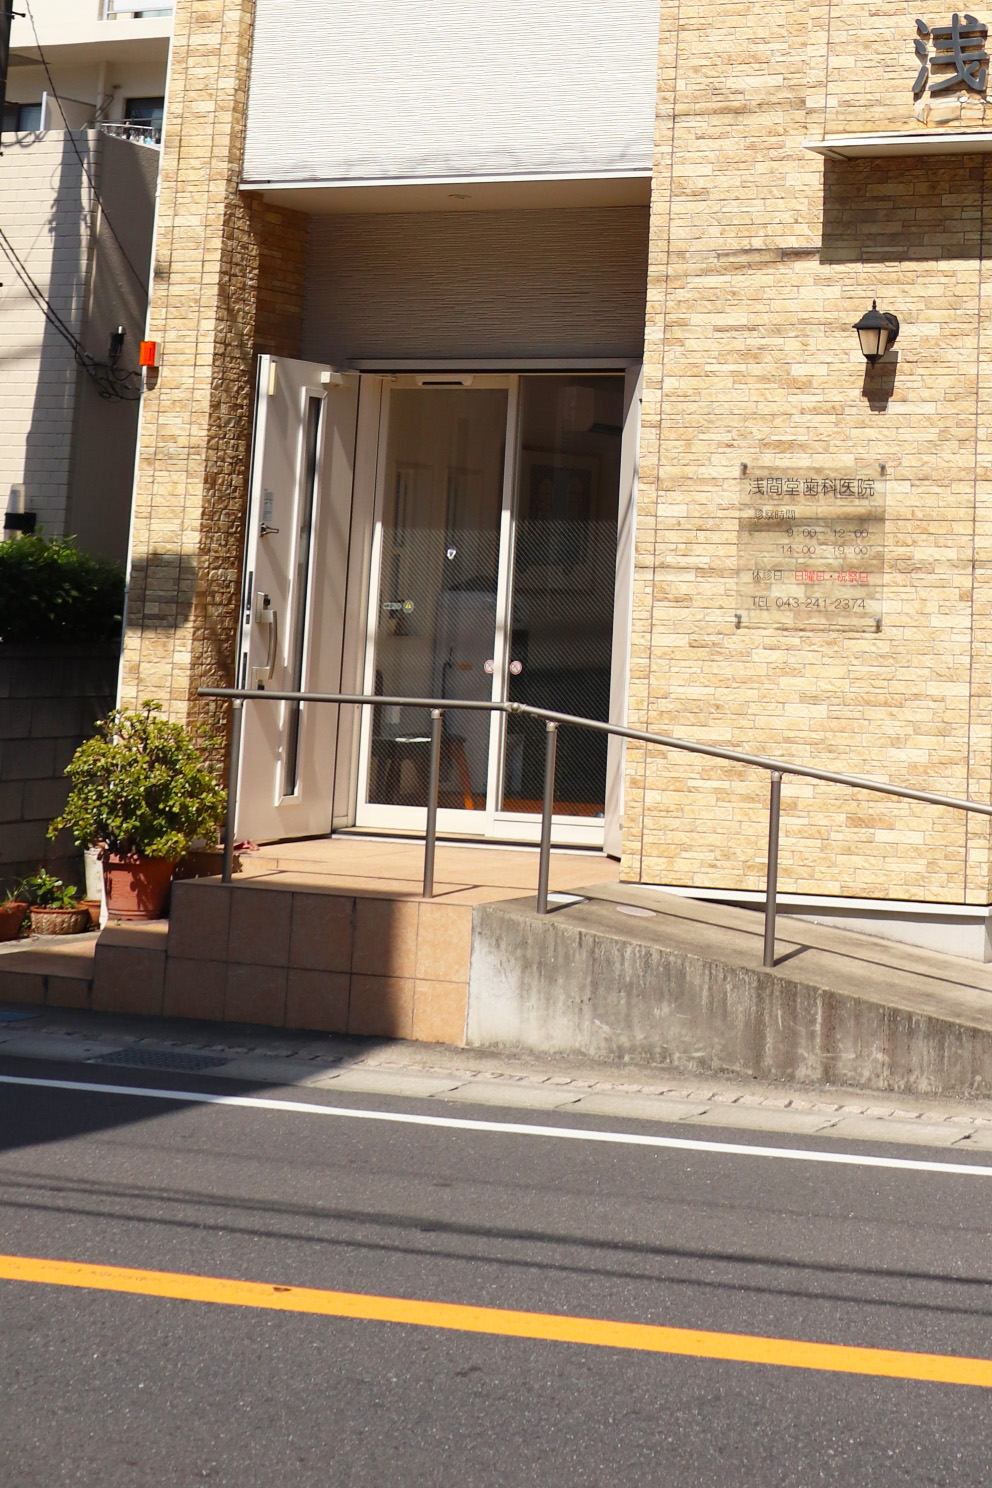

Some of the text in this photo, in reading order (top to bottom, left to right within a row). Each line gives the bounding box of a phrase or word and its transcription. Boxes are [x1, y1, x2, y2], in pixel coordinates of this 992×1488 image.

[748, 477, 875, 497] 浅間堂歯科医院
[751, 596, 867, 610] TEL 043-241-2374
